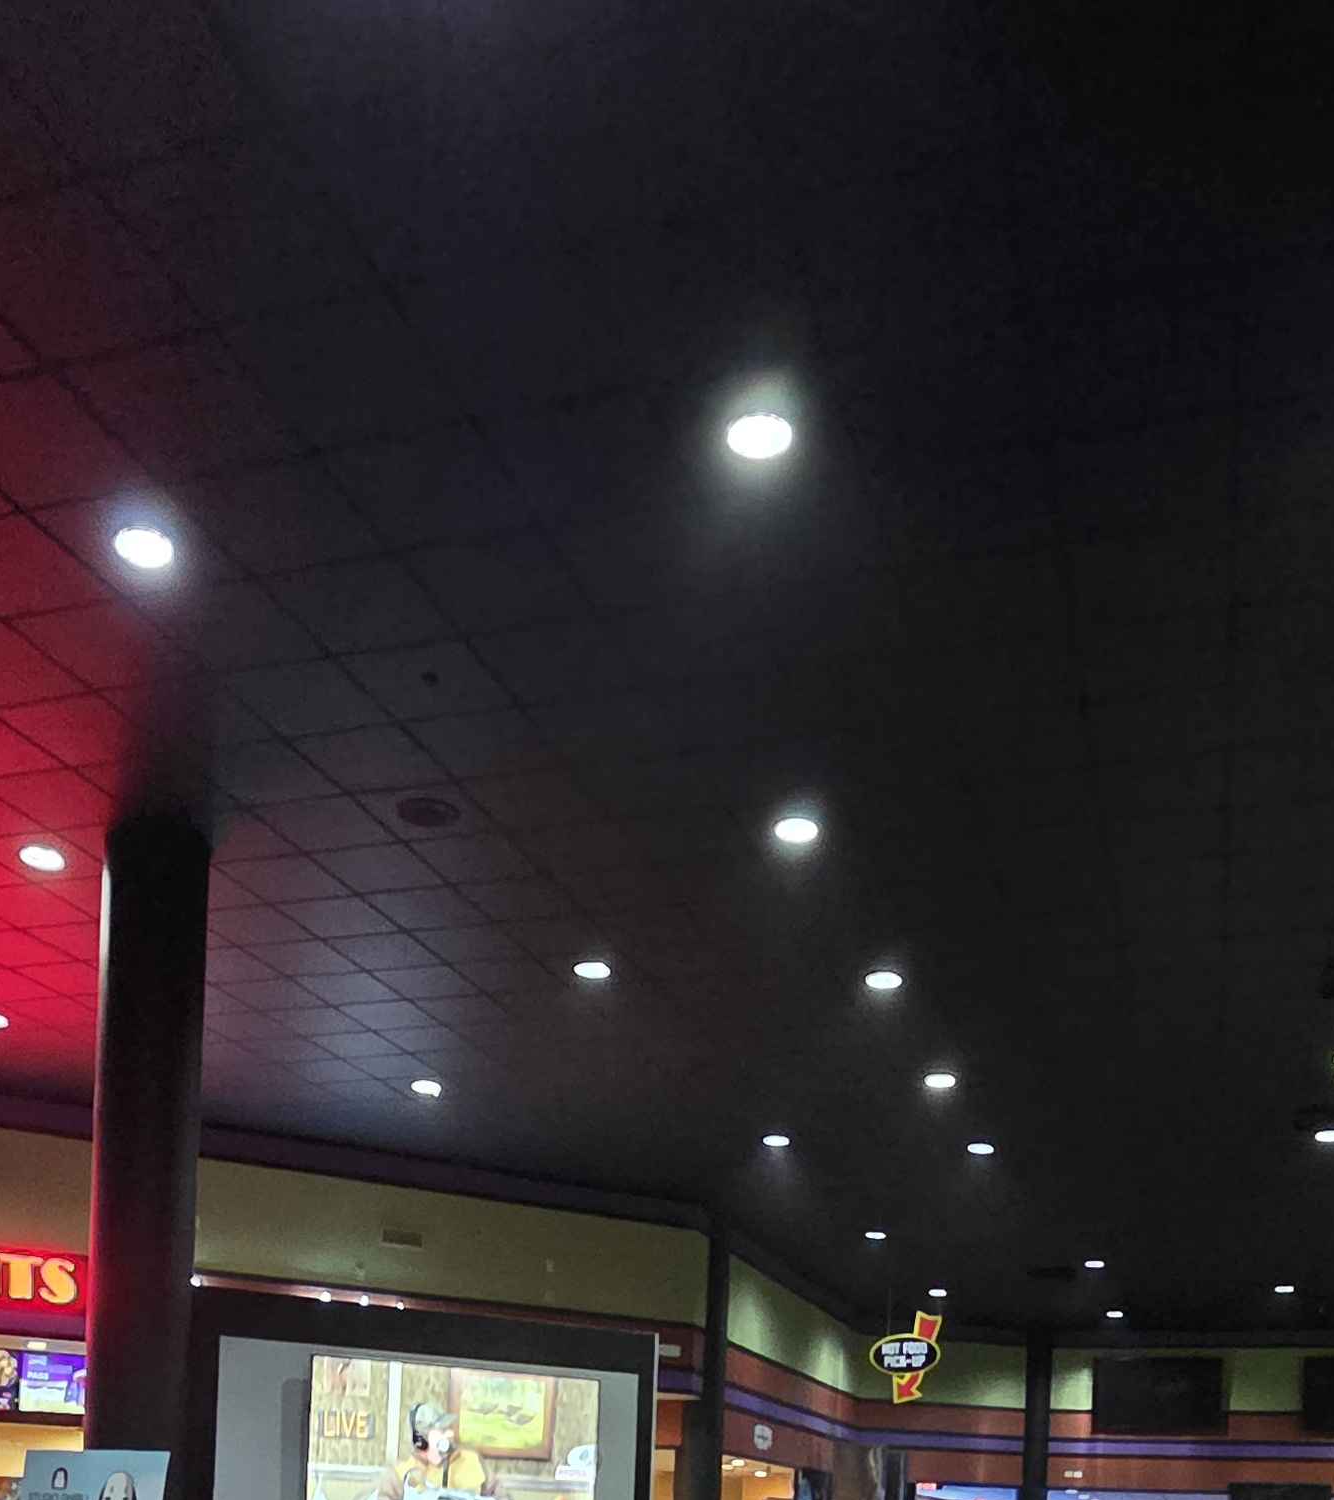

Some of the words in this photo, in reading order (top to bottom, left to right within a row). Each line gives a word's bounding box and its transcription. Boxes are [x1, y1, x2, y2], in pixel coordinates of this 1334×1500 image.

[882, 1342, 900, 1355] HOT
[903, 1341, 928, 1355] FOOD
[884, 1355, 926, 1368] PICK-UP
[322, 1410, 370, 1440] LIVE
